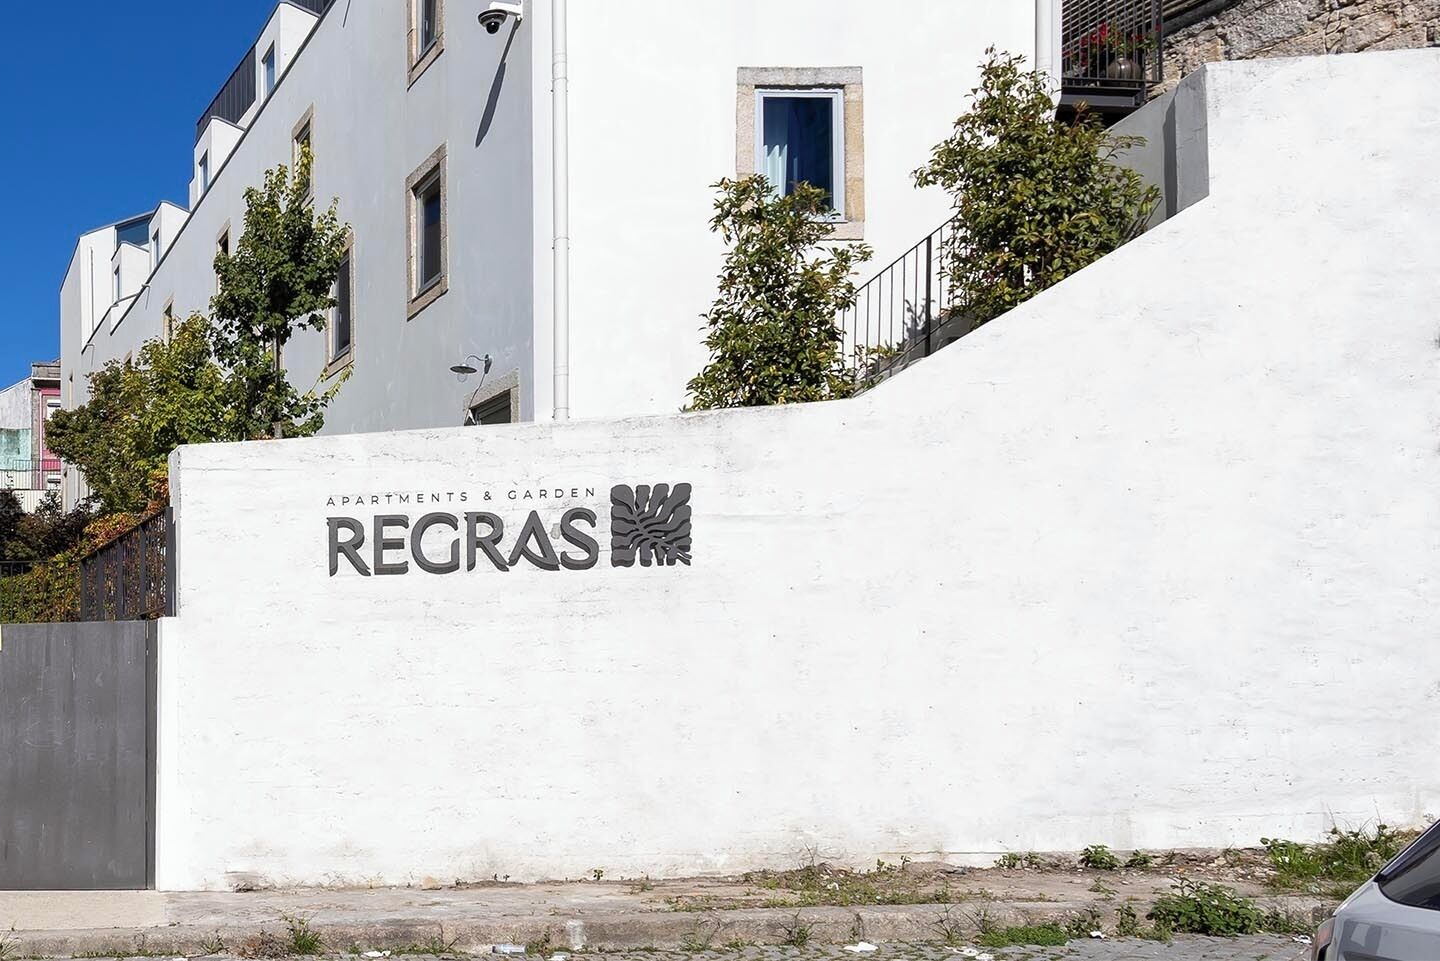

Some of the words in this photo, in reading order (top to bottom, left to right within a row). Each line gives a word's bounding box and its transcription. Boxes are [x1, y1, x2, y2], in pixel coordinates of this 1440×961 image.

[326, 491, 468, 507] APARTMENTS
[483, 490, 493, 502] &
[508, 487, 596, 501] GARDEN
[326, 507, 600, 577] REGRAS
